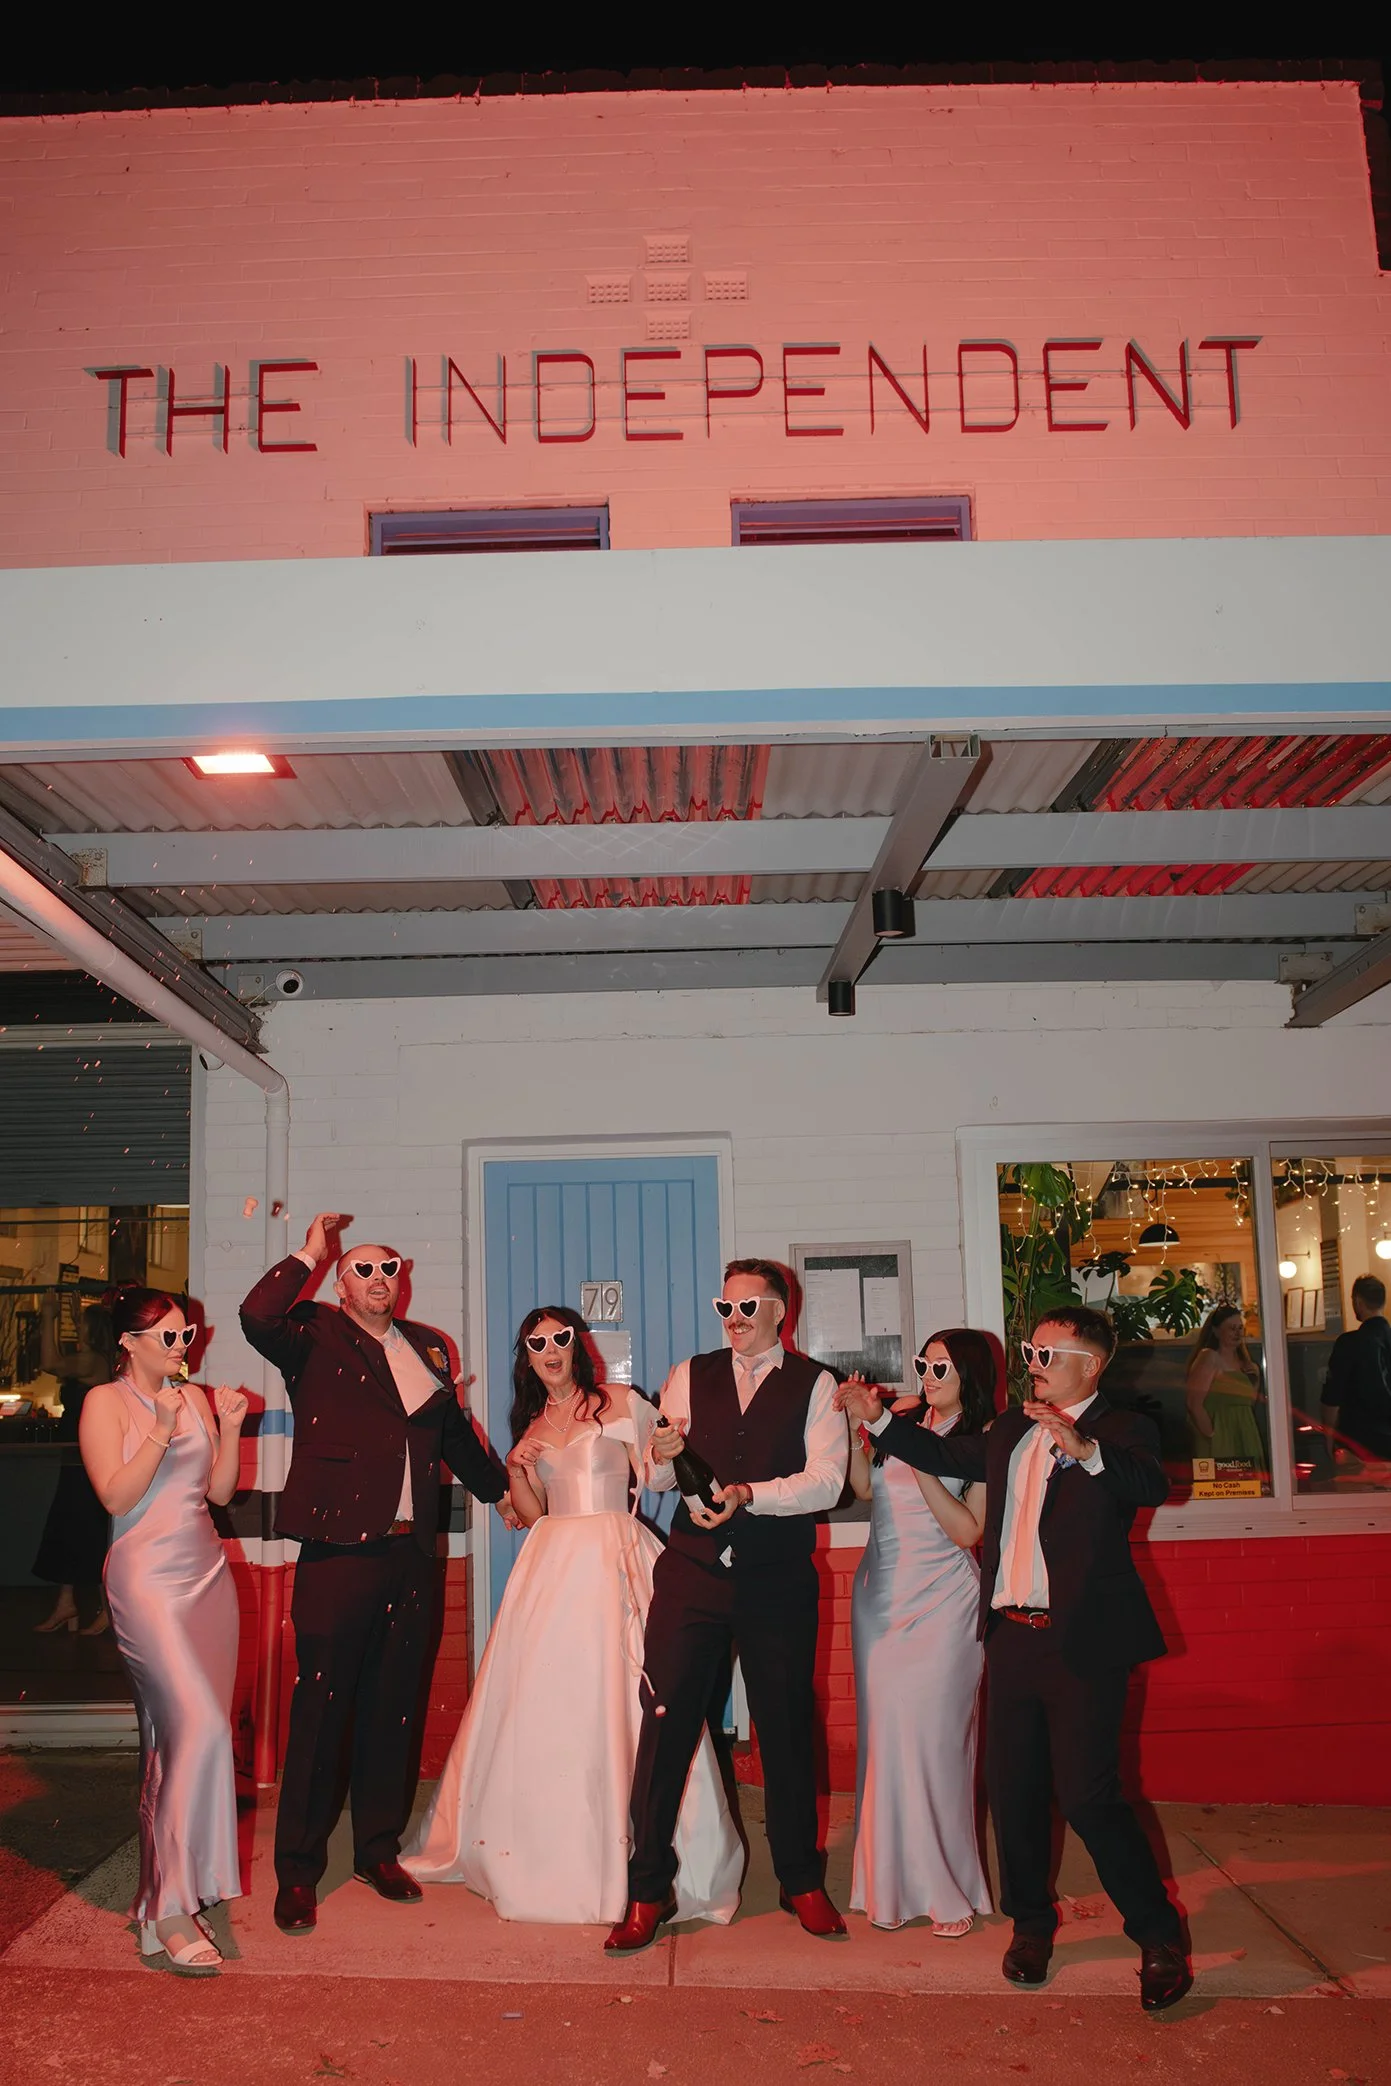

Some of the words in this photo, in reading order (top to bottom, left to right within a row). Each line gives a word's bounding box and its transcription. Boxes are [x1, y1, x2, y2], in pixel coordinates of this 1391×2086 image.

[93, 360, 319, 459] THE
[410, 337, 1259, 449] INDEPENDENT
[585, 1287, 618, 1316] 79
